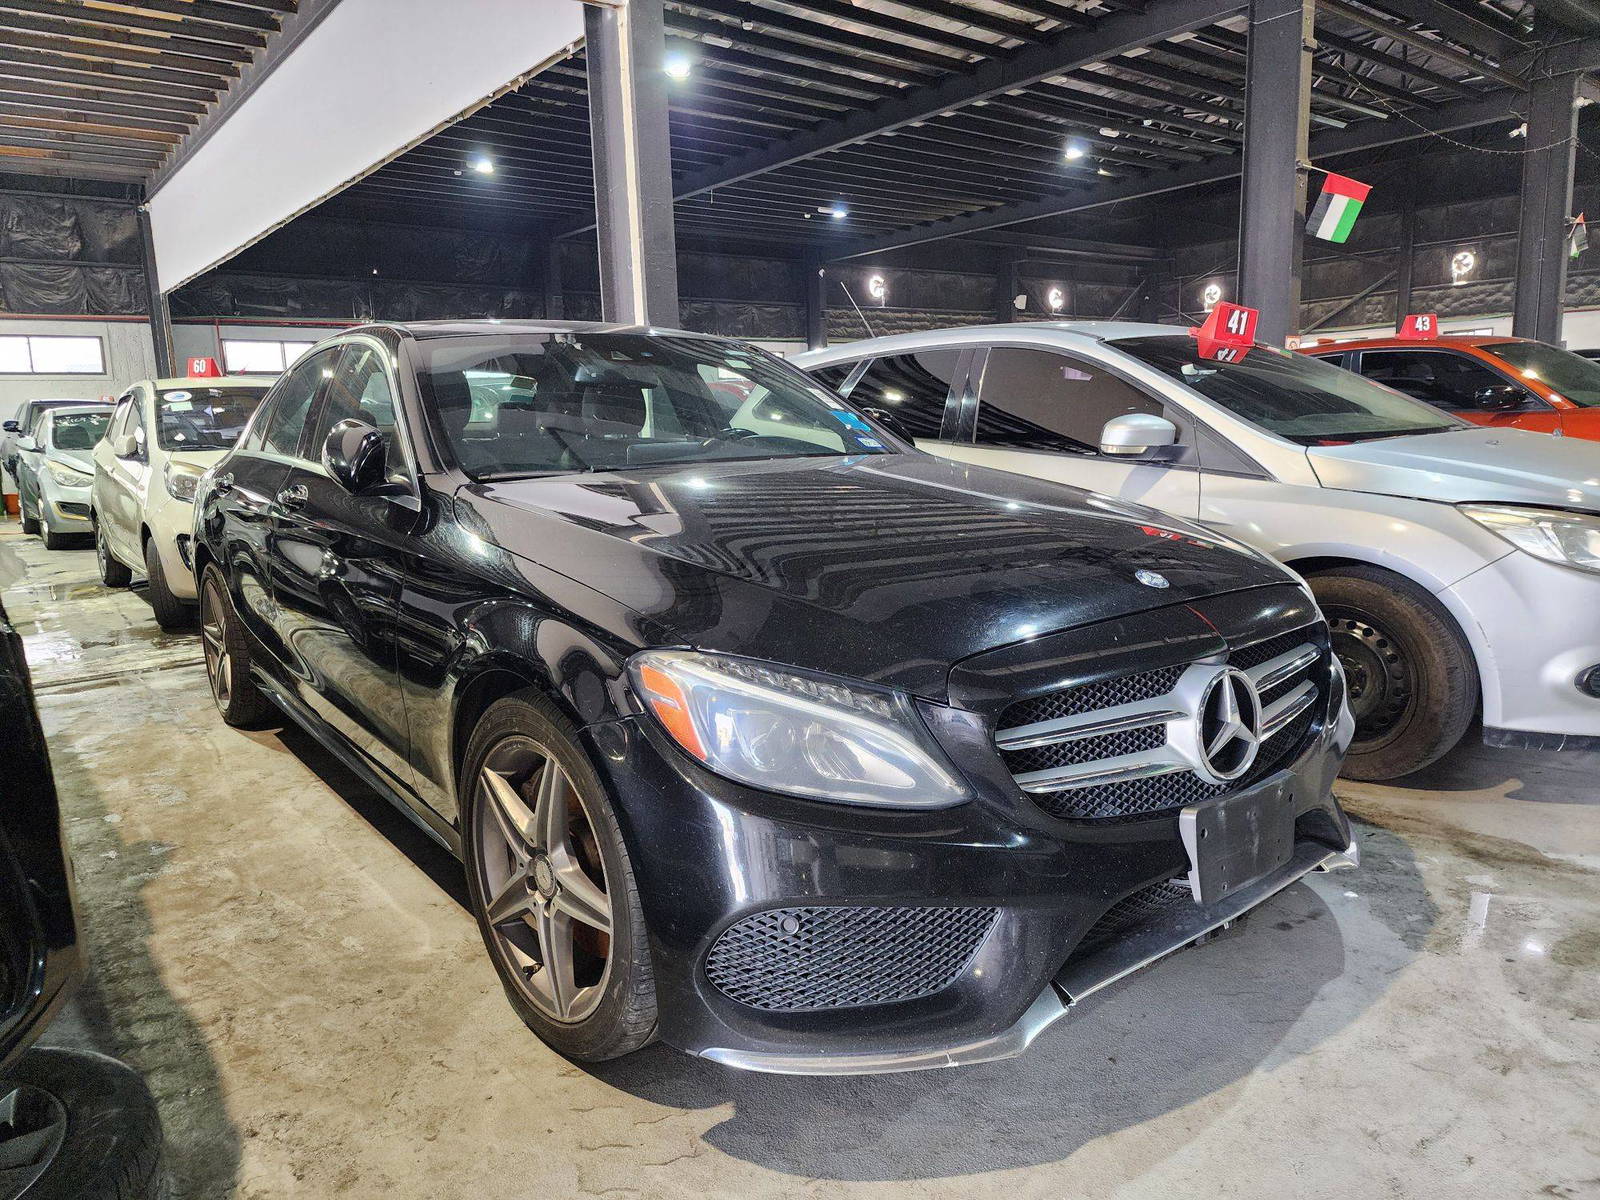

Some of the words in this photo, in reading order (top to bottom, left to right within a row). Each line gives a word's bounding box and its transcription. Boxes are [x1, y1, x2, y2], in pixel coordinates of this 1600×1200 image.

[1228, 309, 1248, 336] 41
[1415, 316, 1431, 332] 43
[193, 359, 206, 374] 60
